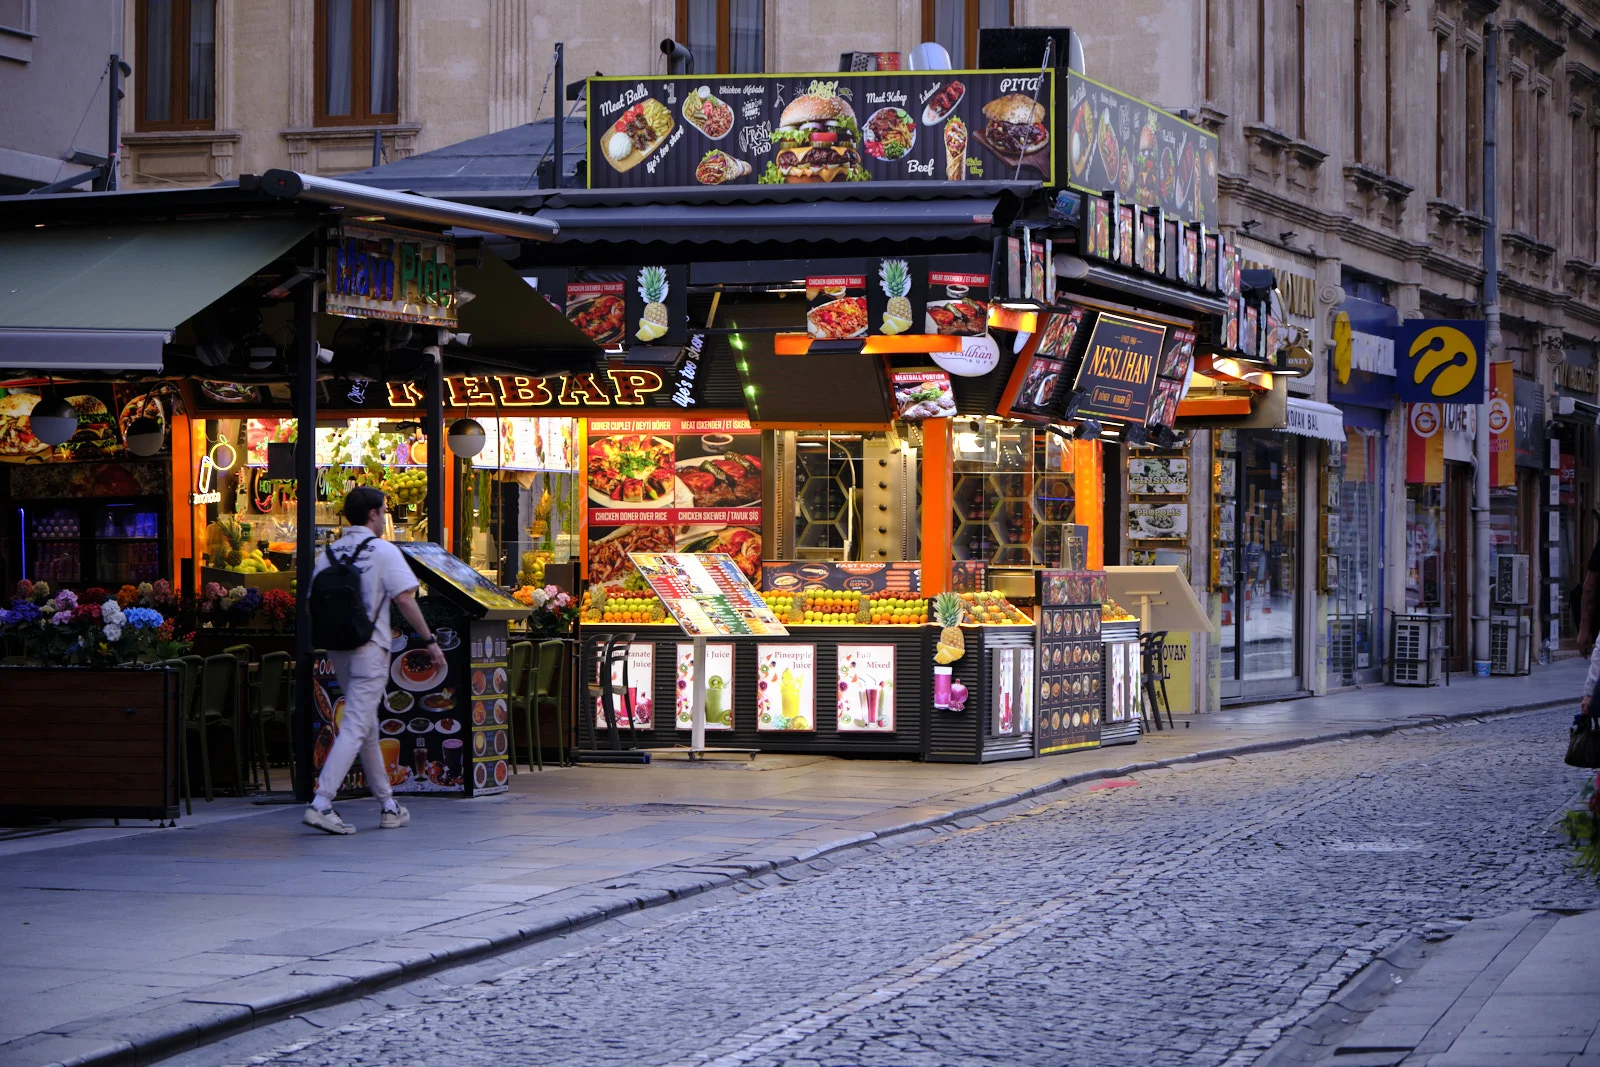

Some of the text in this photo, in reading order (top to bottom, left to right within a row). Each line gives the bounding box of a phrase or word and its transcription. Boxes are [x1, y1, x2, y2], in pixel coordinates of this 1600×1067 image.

[1000, 78, 1040, 93] PITA
[600, 82, 649, 117] Meat Balls
[866, 90, 908, 106] Meat Kebap
[907, 159, 935, 176] Beef
[336, 237, 452, 307] Mavi Pide
[948, 344, 993, 359] eslihan
[1087, 344, 1153, 385] NESLİHAN
[672, 333, 705, 408] life's too shor
[387, 370, 663, 406] KEBAP
[681, 421, 696, 430] MEAT
[726, 420, 732, 430] ET
[1308, 414, 1319, 431] BAL
[1131, 476, 1184, 485] GINSENG
[595, 511, 620, 521] CHICKEN
[639, 511, 655, 521] OVER
[654, 511, 668, 521] RICE
[678, 511, 703, 521] CHICKEN
[703, 511, 727, 521] SKEWER
[730, 511, 749, 521] TAVUK
[1136, 507, 1181, 516] PROPOLİS
[711, 650, 730, 659] Juice
[774, 651, 812, 660] Pineapple
[856, 651, 872, 659] Full
[633, 660, 651, 669] Juice
[793, 661, 812, 669] Juice
[866, 661, 891, 669] Mixed
